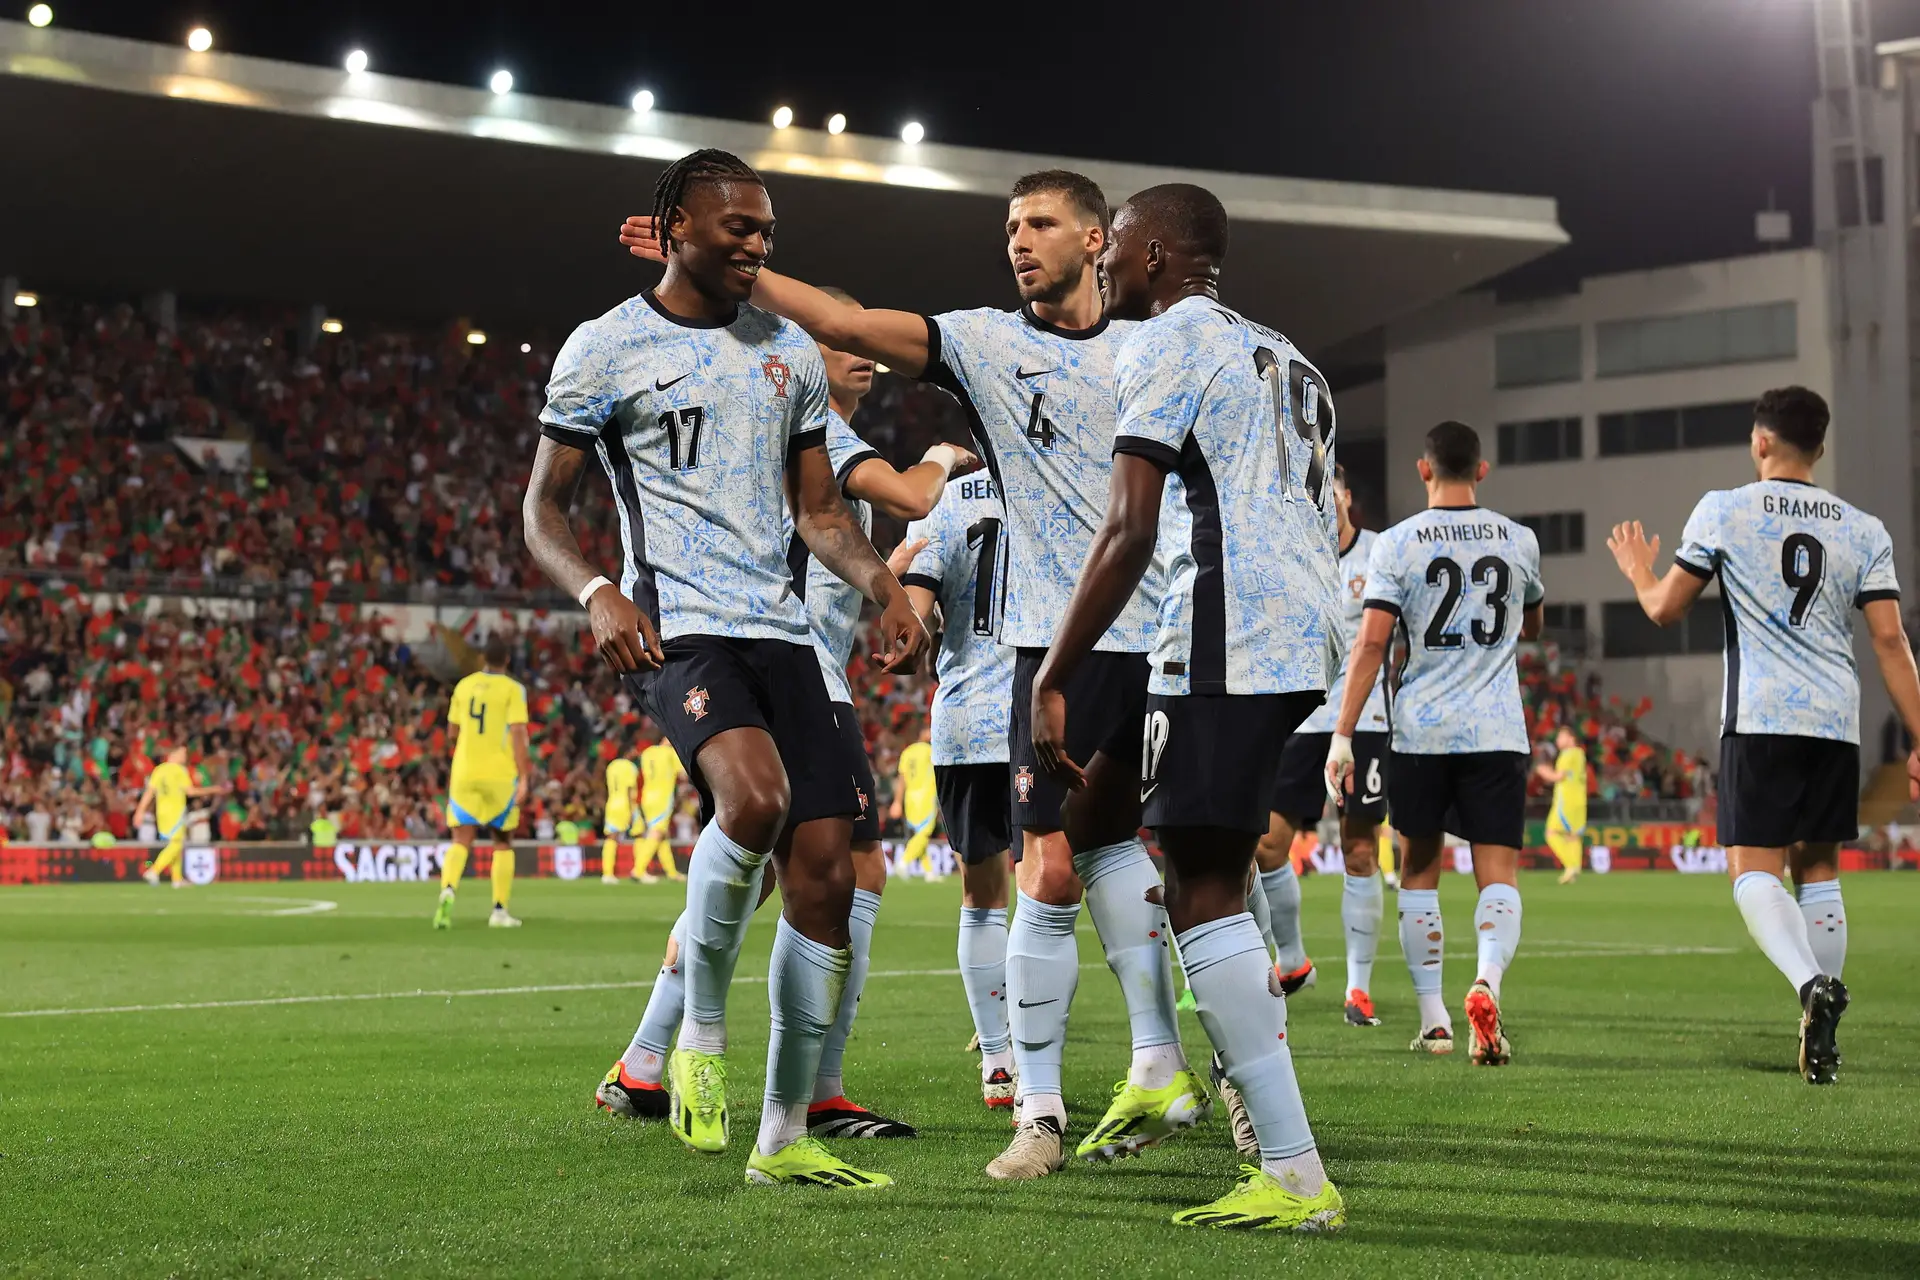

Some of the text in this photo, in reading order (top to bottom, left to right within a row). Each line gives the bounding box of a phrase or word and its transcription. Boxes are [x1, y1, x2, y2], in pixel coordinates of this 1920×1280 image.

[657, 406, 704, 471] 17
[1027, 393, 1056, 450] 4
[1253, 345, 1334, 512] 19
[1416, 523, 1509, 544] MATHEUS N
[966, 517, 1003, 637] 1
[1424, 555, 1513, 652] 23
[1781, 532, 1827, 630] 9
[469, 695, 486, 735] 4
[1141, 710, 1170, 781] 19
[1366, 757, 1382, 794] 6
